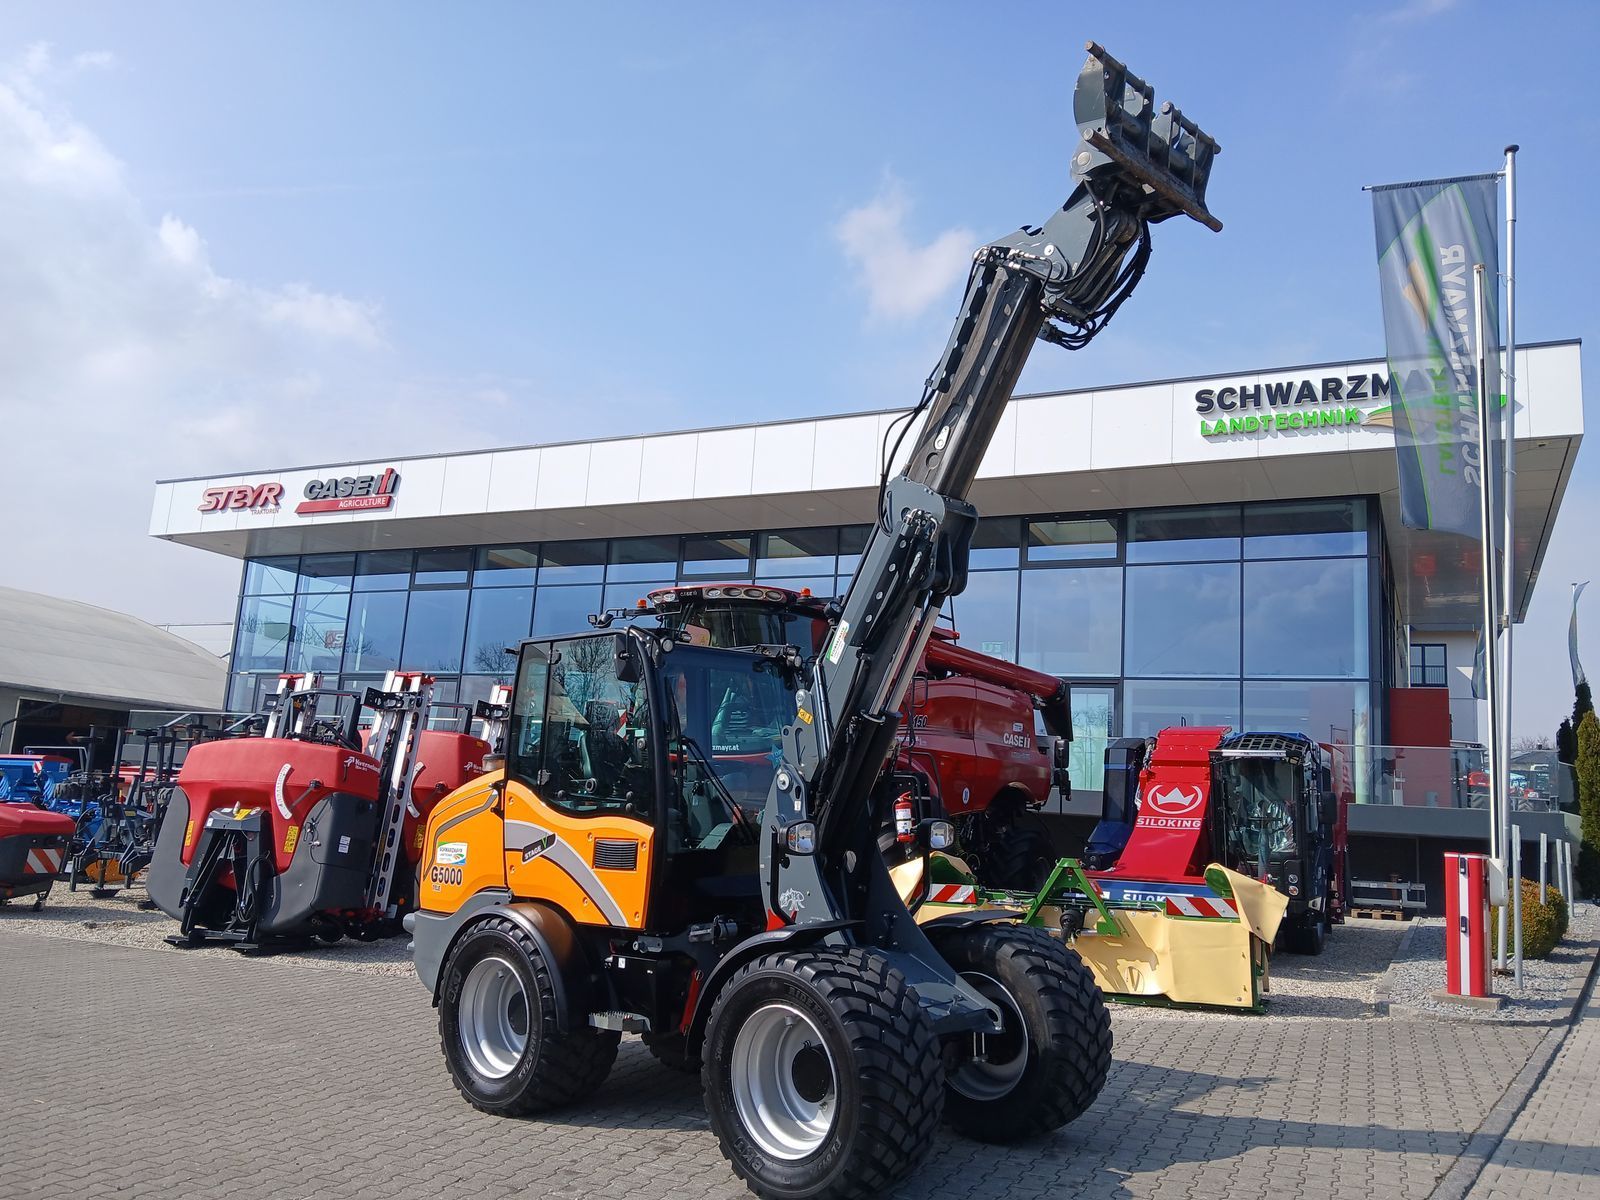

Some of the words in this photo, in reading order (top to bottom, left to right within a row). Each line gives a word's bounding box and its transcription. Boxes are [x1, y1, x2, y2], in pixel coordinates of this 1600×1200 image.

[1201, 408, 1360, 436] LANDTECHNIK
[304, 475, 375, 500] CASE
[198, 483, 283, 512] STEYR
[338, 497, 387, 508] AGRICULTURE
[913, 714, 928, 728] 150
[1003, 732, 1024, 748] CASE
[712, 744, 739, 752] zmayr.at
[1137, 817, 1202, 828] SILOKING
[524, 845, 542, 860] STAGE
[431, 866, 462, 886] G5000
[1123, 893, 1167, 902] SILOK
